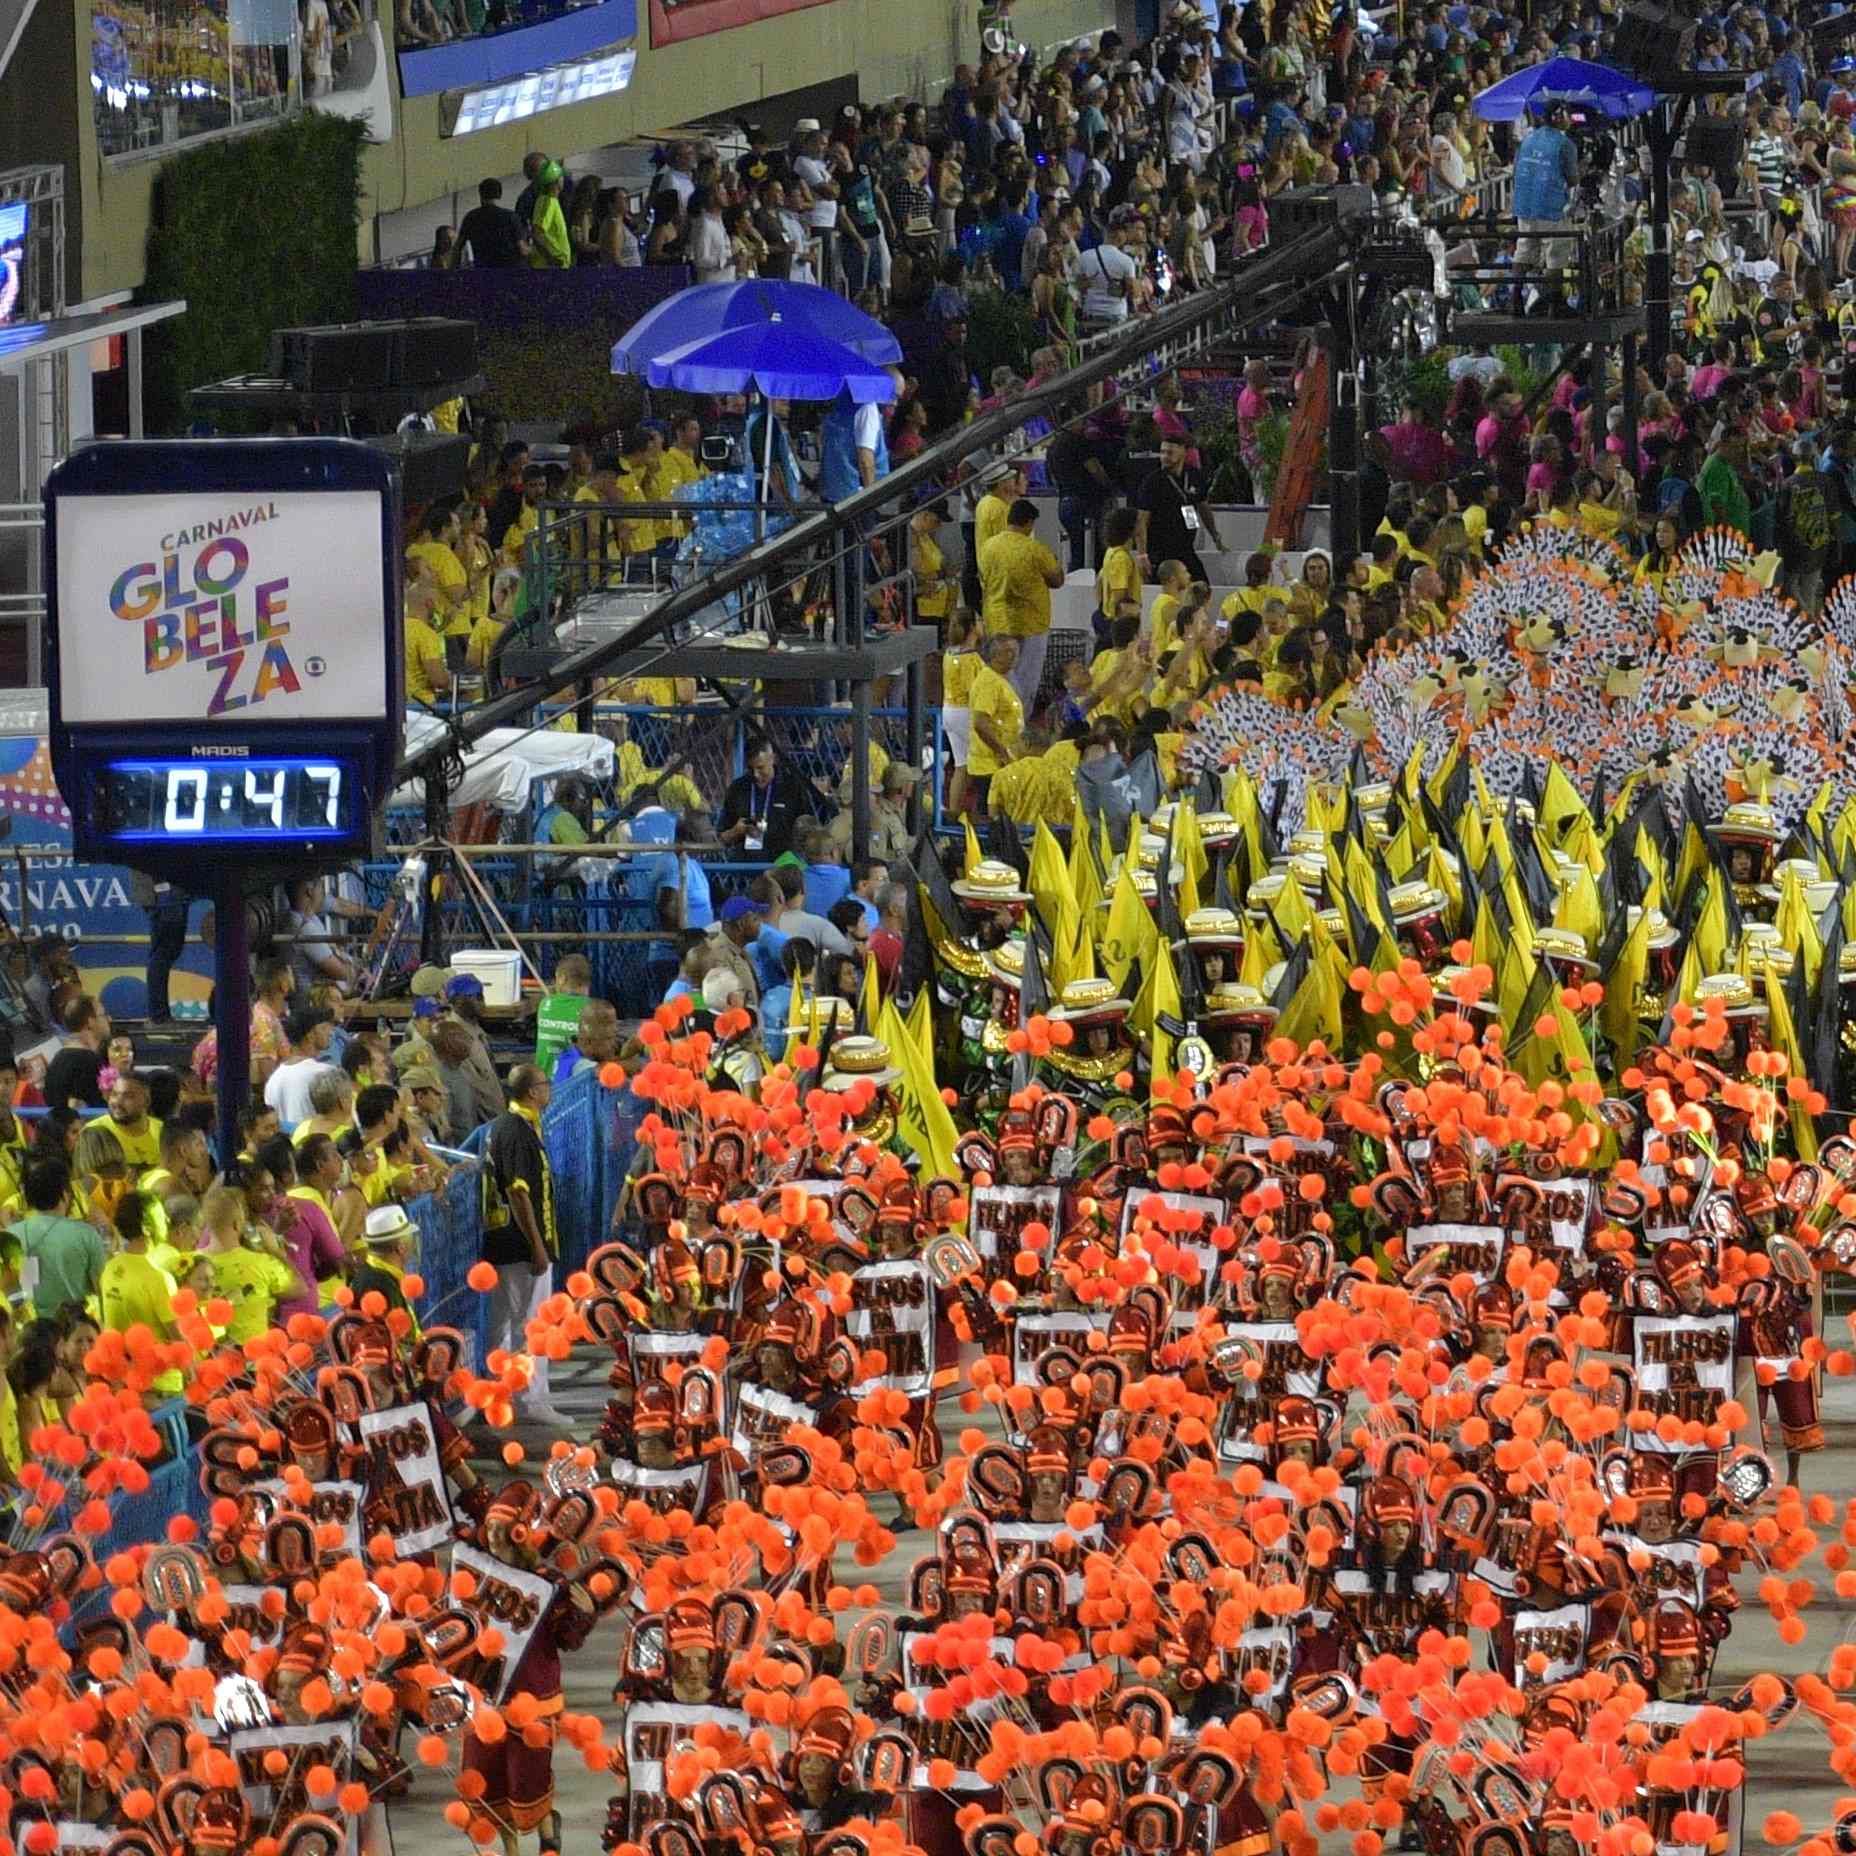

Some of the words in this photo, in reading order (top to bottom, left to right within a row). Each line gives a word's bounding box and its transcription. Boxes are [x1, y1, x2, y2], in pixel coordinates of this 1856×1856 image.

[160, 501, 281, 553] CARNAVAL
[108, 536, 250, 621] GLO
[144, 576, 292, 675] BELE
[205, 637, 302, 718] ZA
[163, 766, 341, 832] 0:47
[1640, 1328, 1731, 1367] FILHOS
[1666, 1361, 1699, 1391] DA
